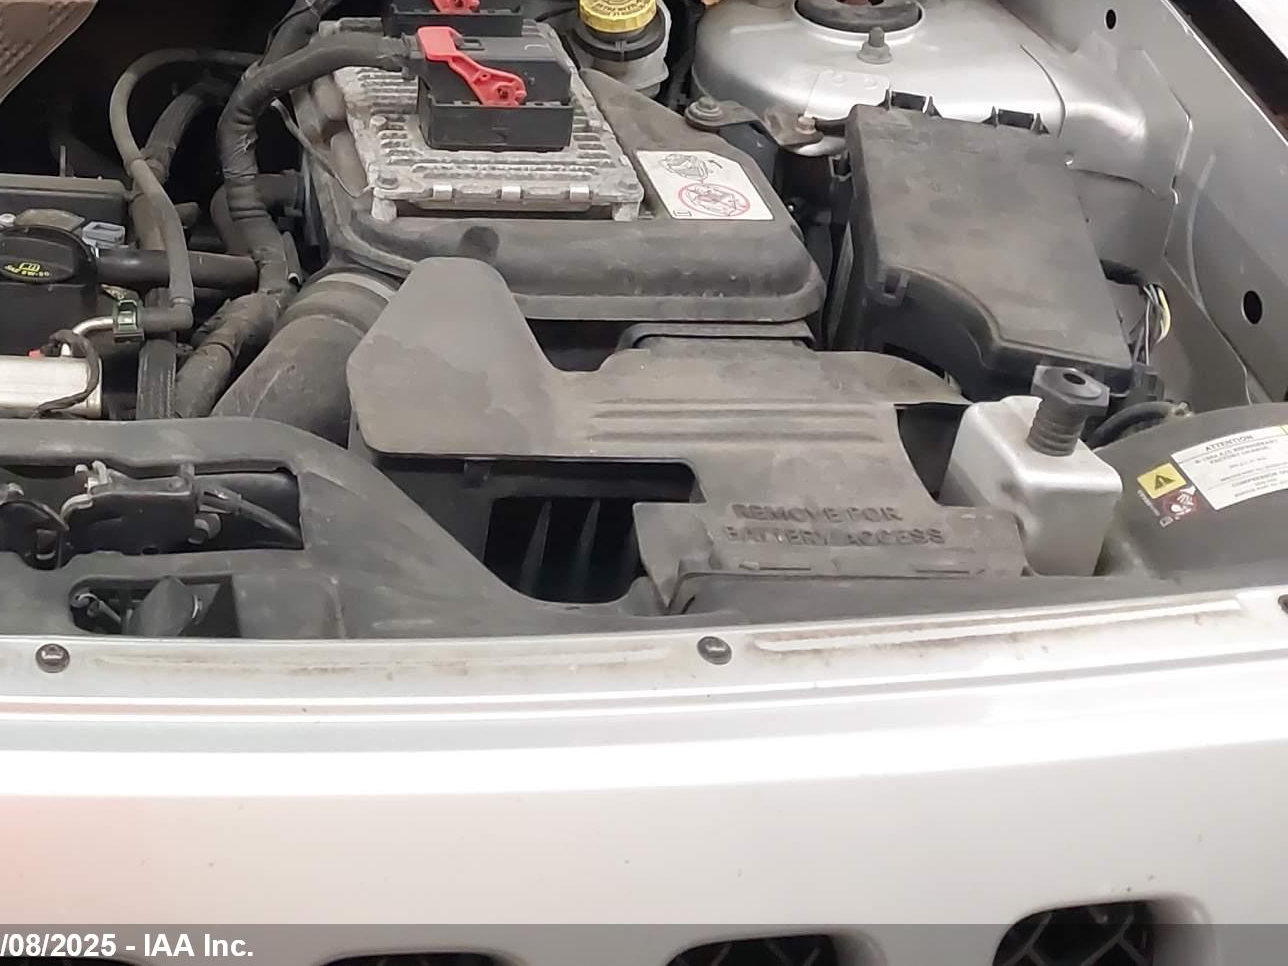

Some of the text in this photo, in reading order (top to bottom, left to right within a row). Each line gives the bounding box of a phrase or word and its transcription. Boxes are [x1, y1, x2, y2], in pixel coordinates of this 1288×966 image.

[1205, 435, 1254, 451] ATTENTION
[731, 503, 904, 523] REMOVE FOR
[725, 525, 947, 546] BATTERY ACCESS
